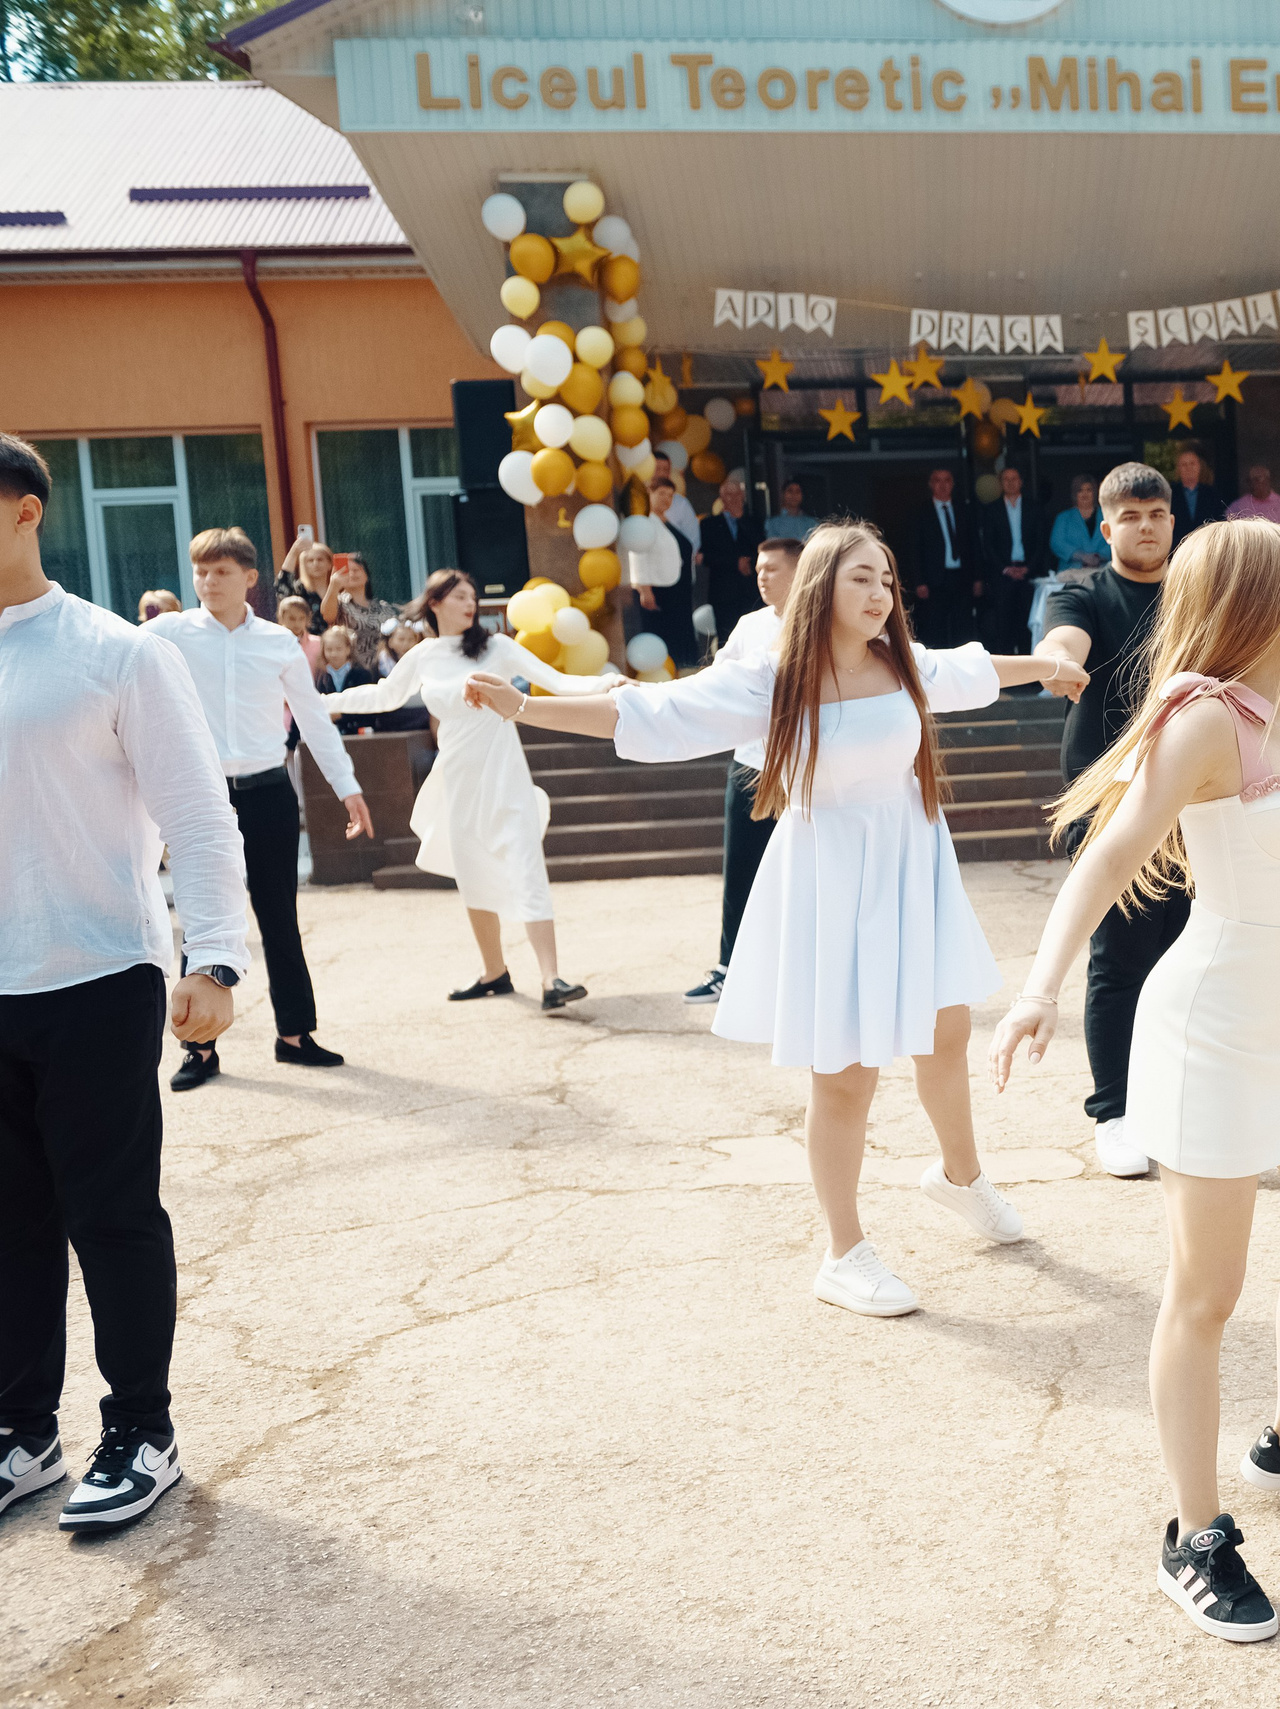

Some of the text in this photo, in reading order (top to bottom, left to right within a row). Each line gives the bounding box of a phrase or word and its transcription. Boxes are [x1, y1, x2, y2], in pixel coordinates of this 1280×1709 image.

[415, 52, 648, 113] Liceul
[669, 53, 968, 114] Teoretic
[717, 293, 834, 325] ADIO
